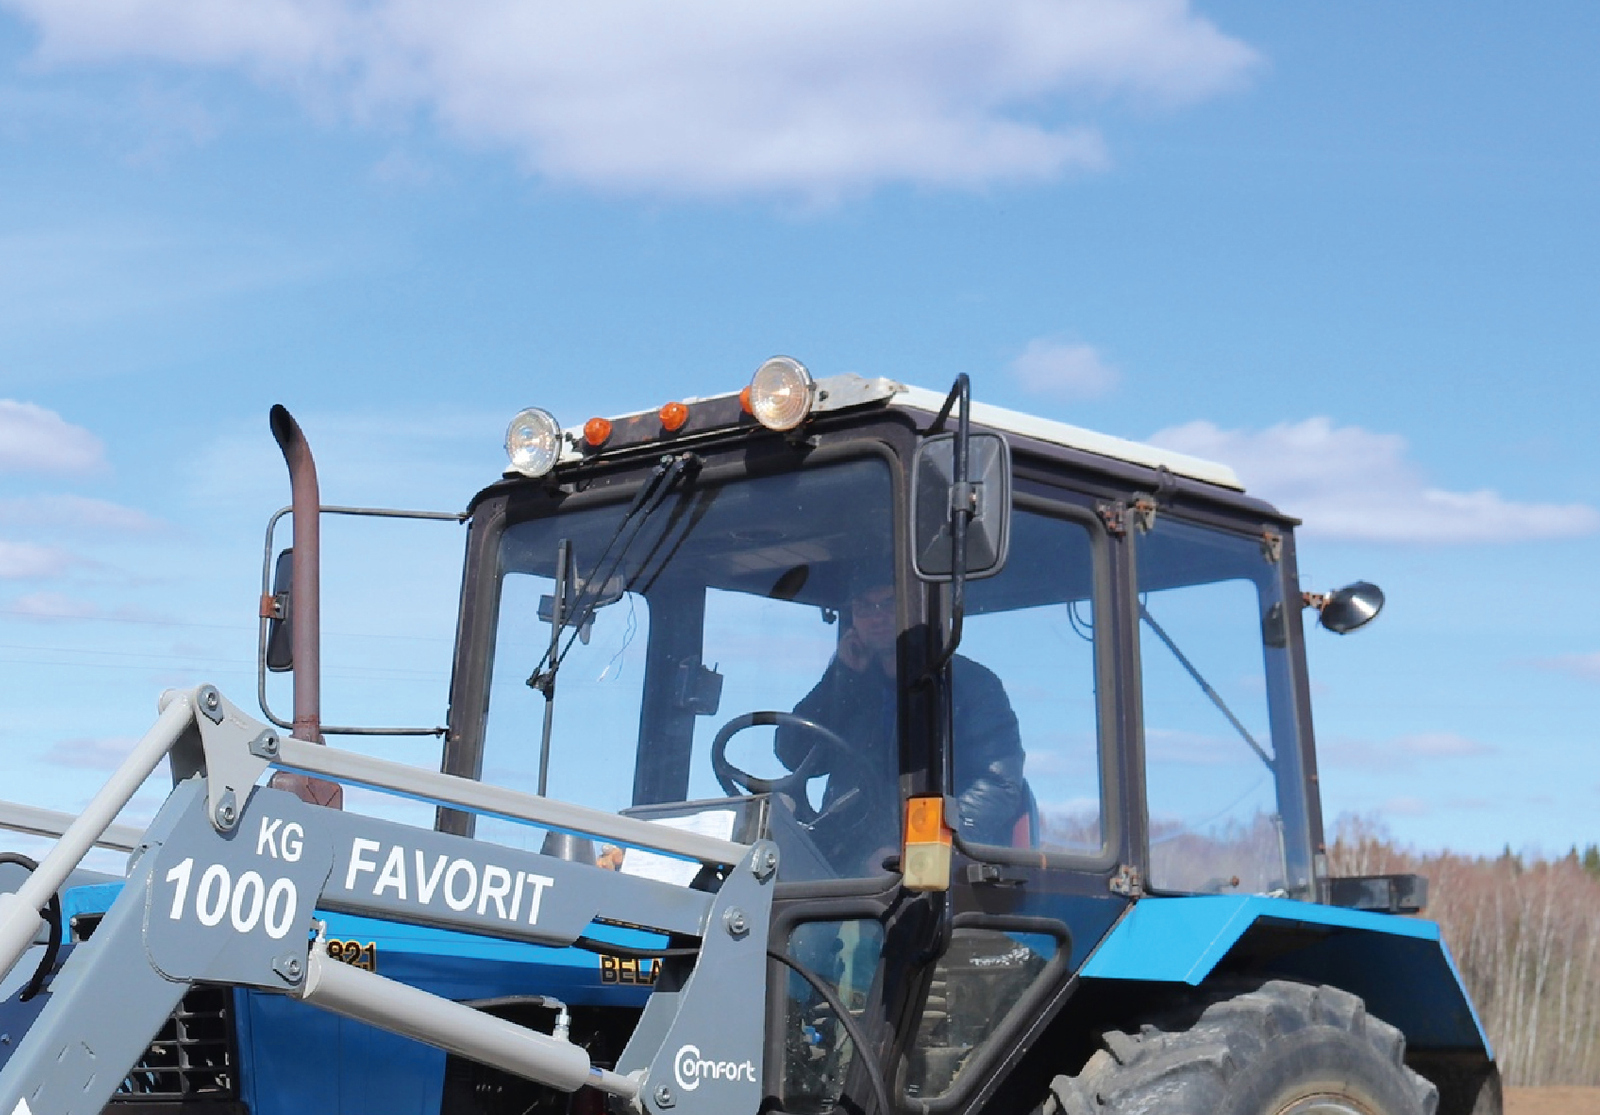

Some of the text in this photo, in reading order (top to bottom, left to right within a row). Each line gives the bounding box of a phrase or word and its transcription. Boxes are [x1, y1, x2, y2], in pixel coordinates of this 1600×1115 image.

[257, 816, 305, 864] KG
[165, 857, 298, 939] 1000
[345, 837, 555, 926] FAVORIT
[599, 954, 664, 987] BELA
[674, 1044, 757, 1091] Comfort
